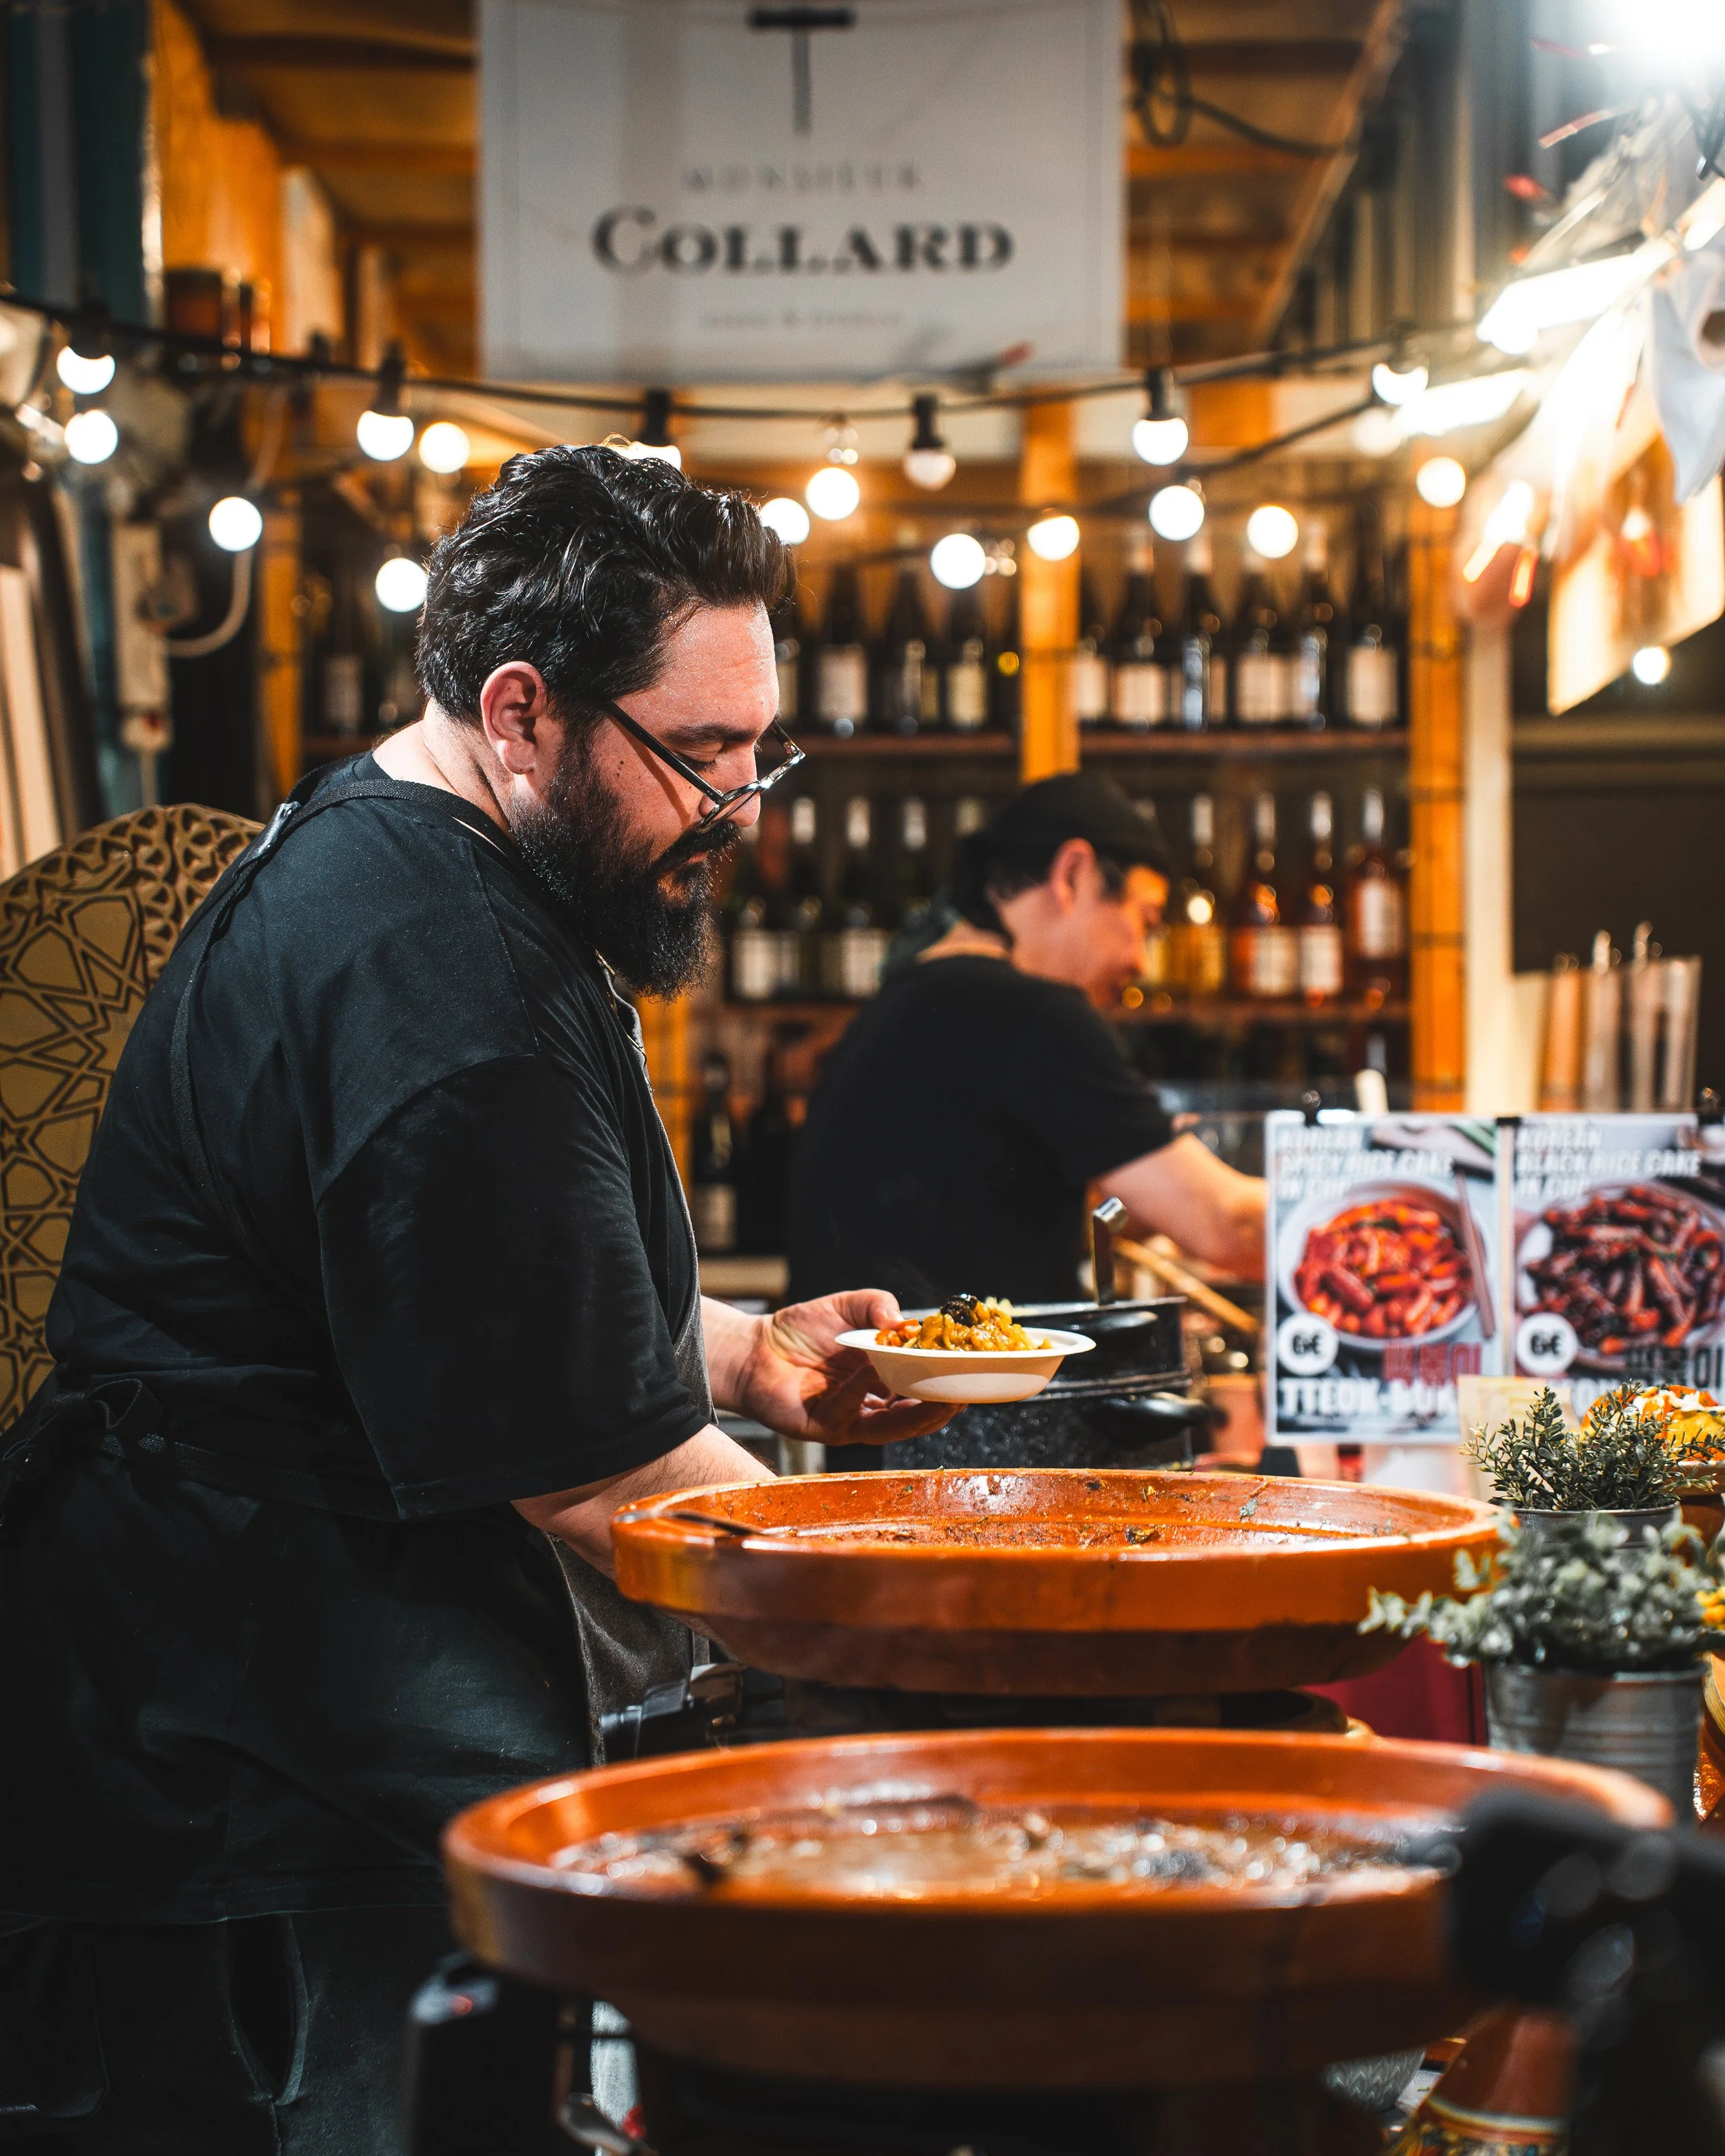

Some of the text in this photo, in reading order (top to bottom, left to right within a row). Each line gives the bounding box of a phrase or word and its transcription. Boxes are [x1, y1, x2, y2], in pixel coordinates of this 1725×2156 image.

[591, 206, 1015, 274] COLLARD
[1518, 1127, 1601, 1148] KOREAN
[1396, 1151, 1454, 1176] CAKE
[1517, 1152, 1588, 1175] BLACK
[1645, 1150, 1701, 1177] CAKE
